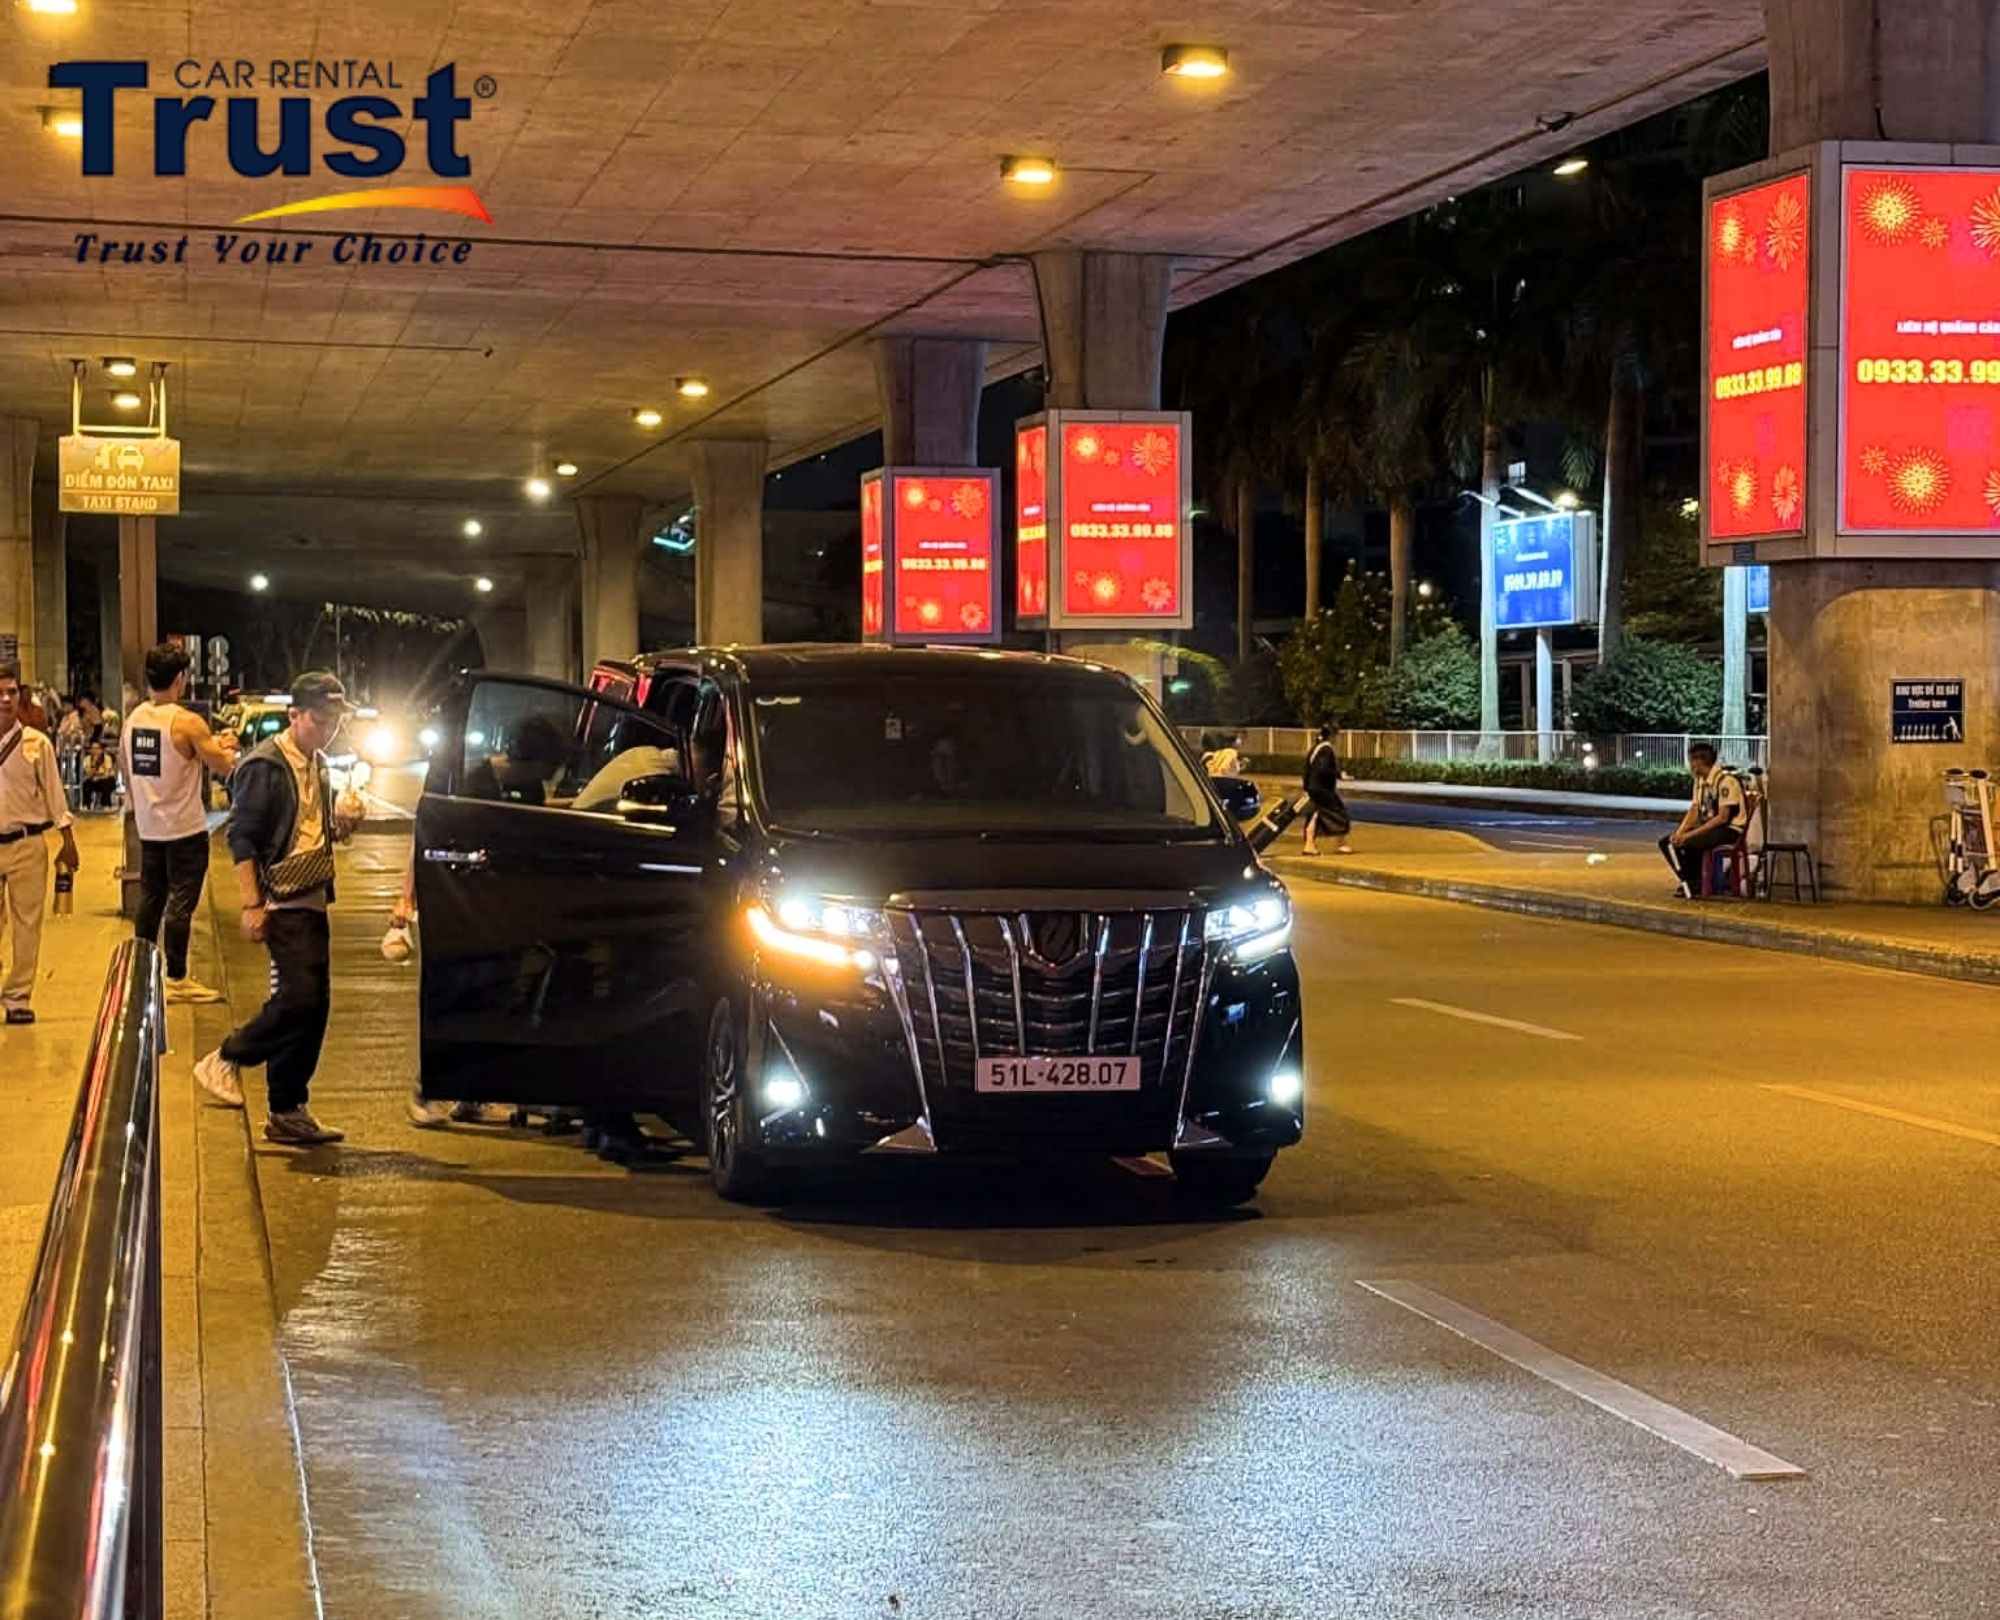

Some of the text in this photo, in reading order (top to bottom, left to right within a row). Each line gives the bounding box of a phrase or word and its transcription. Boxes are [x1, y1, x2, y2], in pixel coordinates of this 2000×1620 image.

[141, 475, 174, 491] TAXI
[83, 495, 157, 511] TAXI STAND
